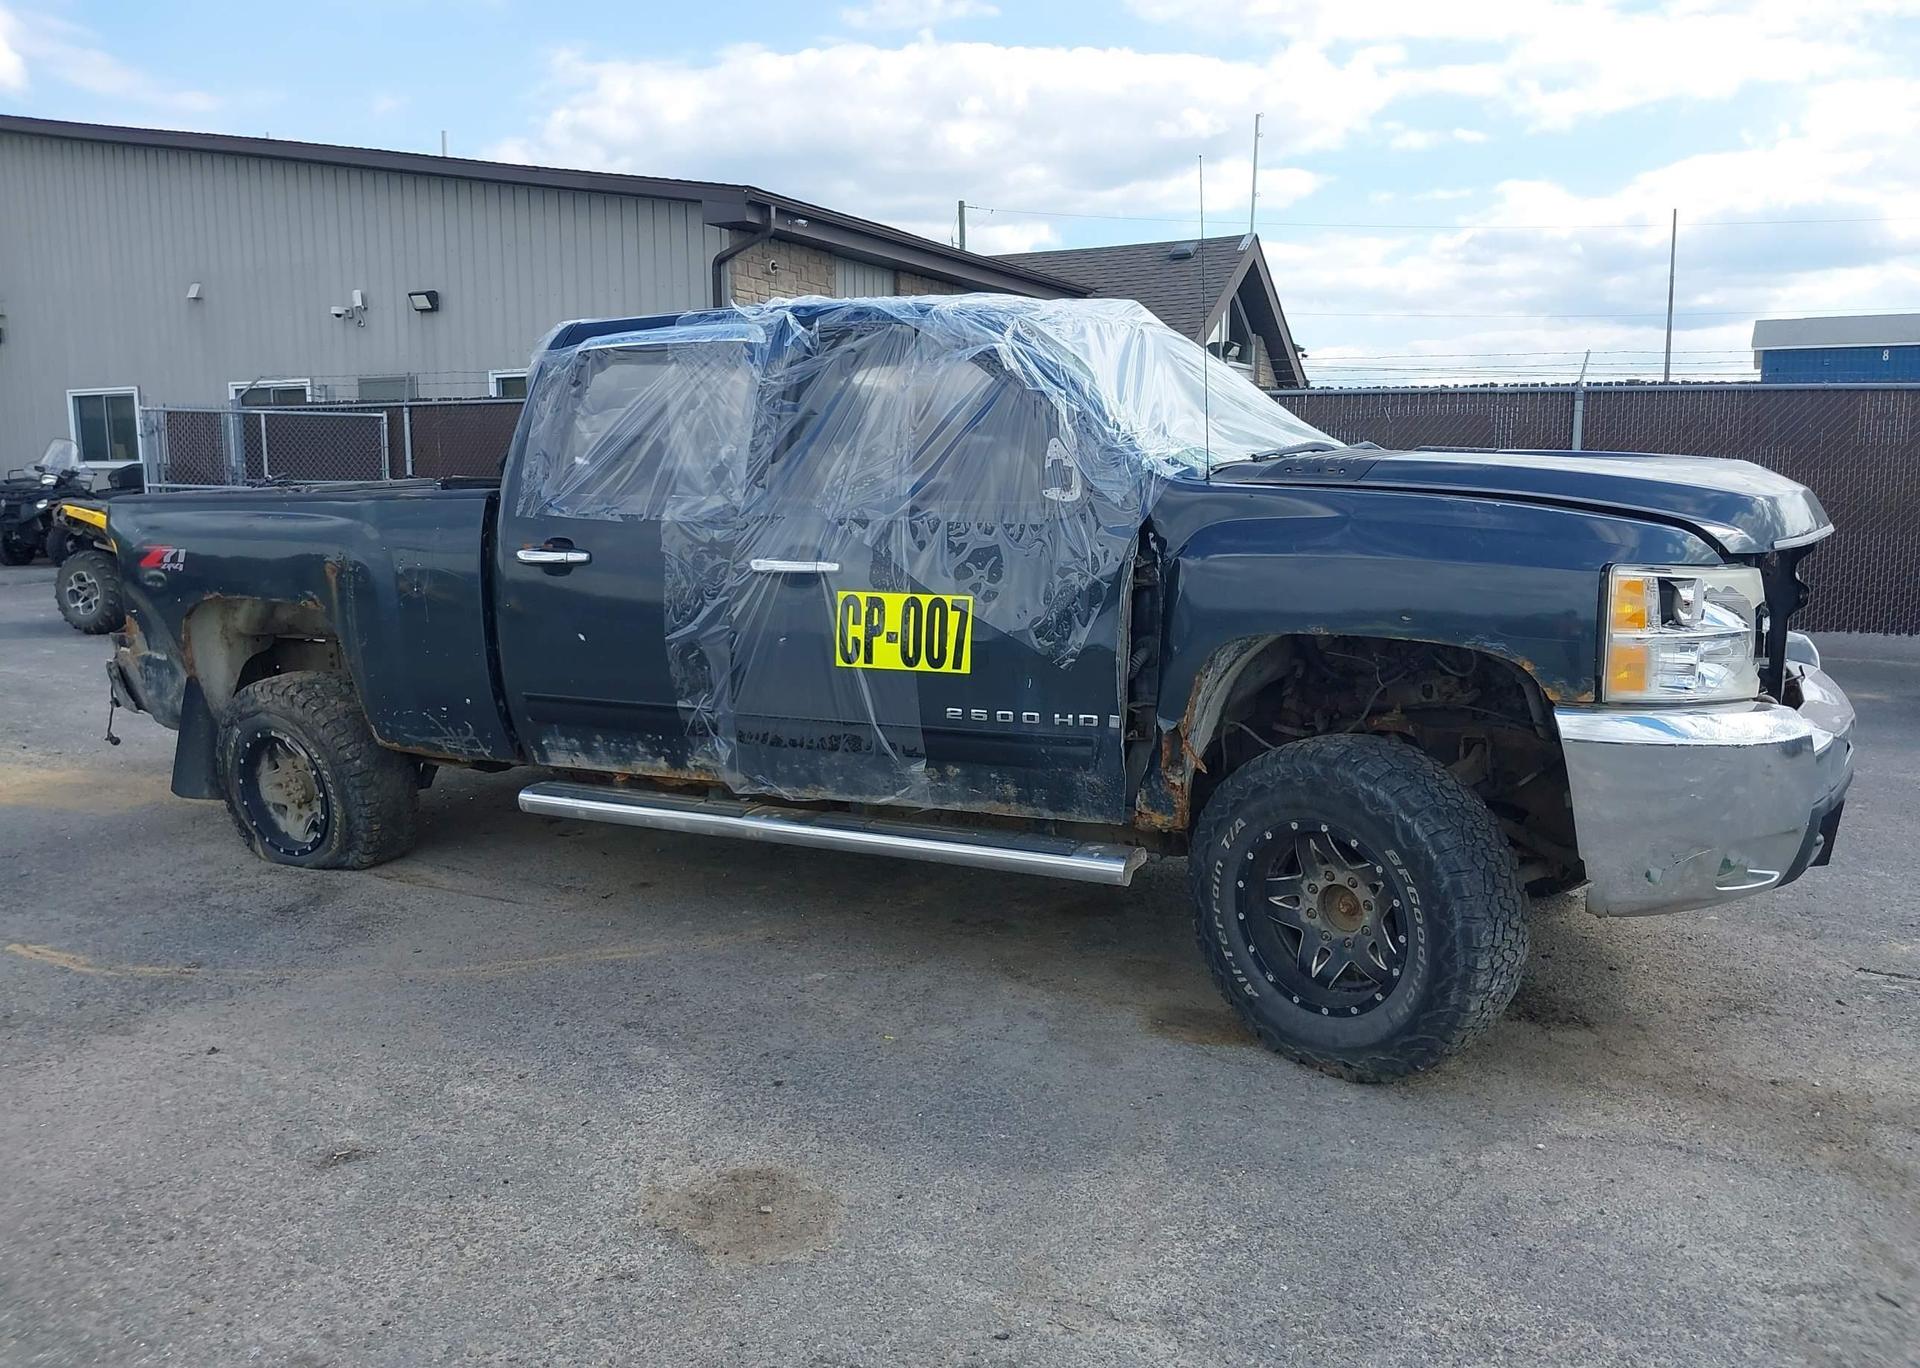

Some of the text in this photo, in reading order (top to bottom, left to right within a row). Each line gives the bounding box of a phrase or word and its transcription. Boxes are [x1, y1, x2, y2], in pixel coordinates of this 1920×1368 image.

[1882, 349, 1889, 361] 8
[140, 544, 186, 568] Z71
[840, 594, 969, 670] CP-007
[946, 707, 1099, 727] 2500 HD
[1221, 817, 1247, 850] T/A
